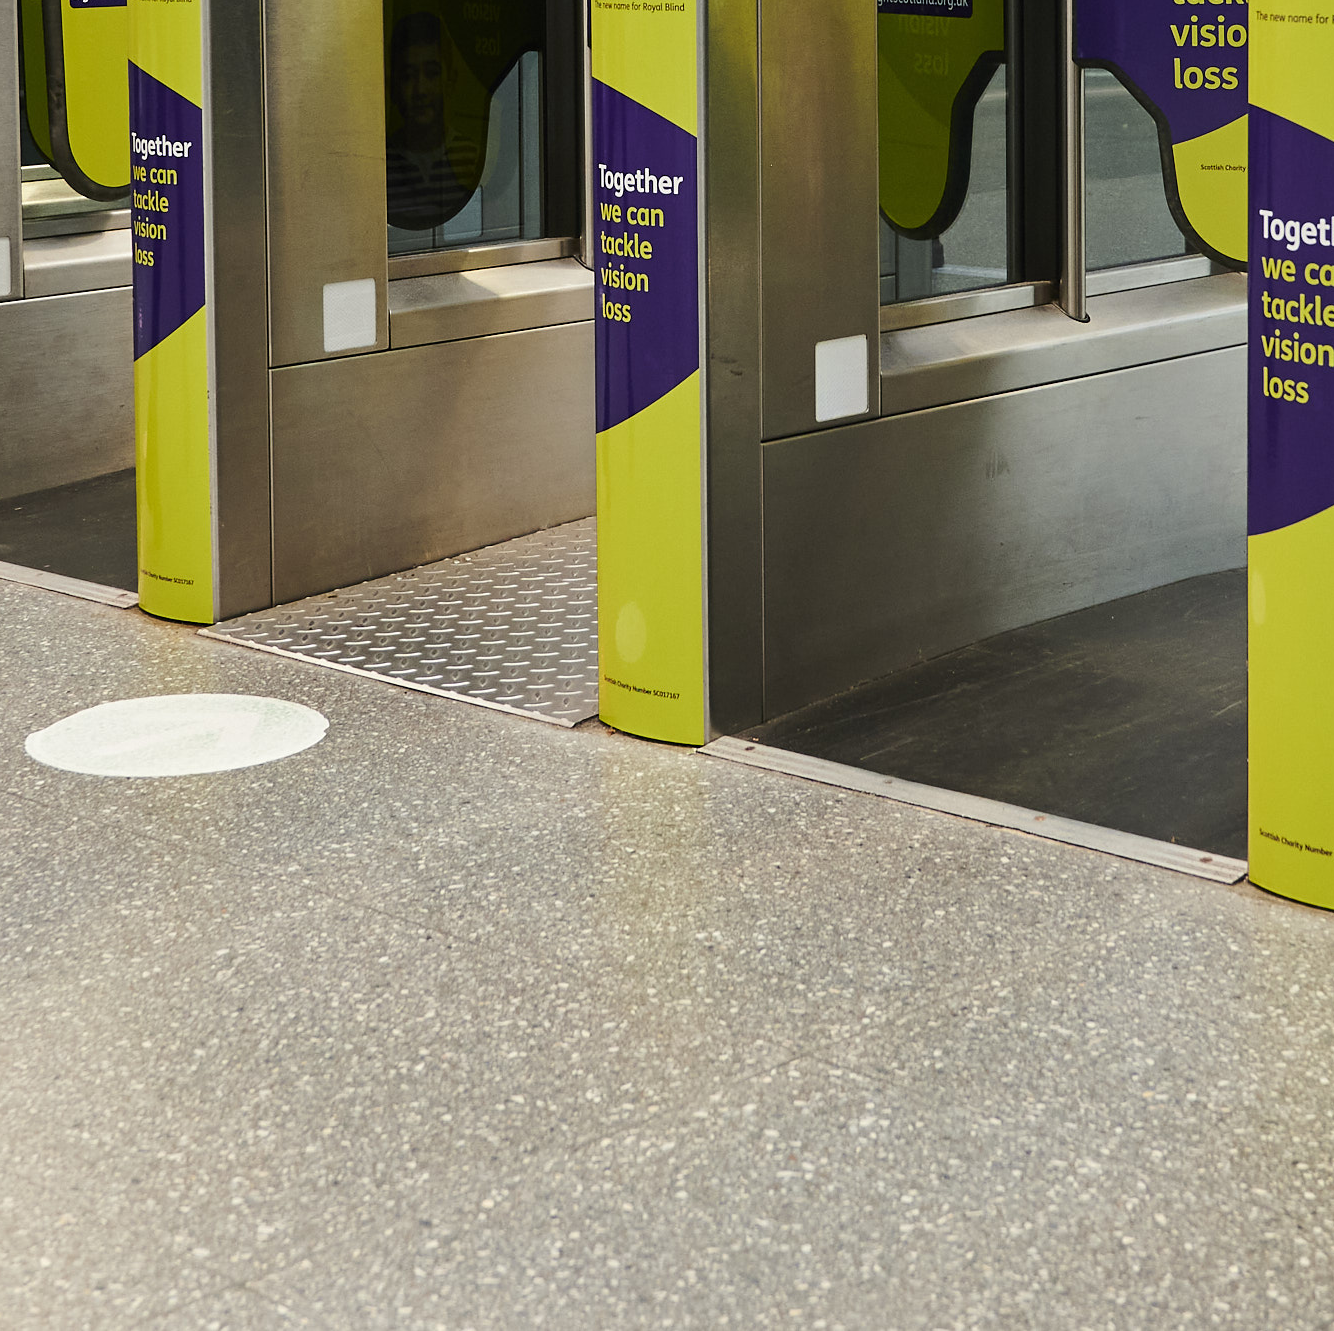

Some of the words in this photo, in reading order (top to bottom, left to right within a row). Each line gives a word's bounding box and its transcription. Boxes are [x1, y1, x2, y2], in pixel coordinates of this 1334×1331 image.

[631, 1, 641, 11] for
[642, 2, 663, 13] Royal
[665, 2, 685, 12] Blind
[1256, 10, 1268, 21] The
[1270, 13, 1286, 22] new
[1287, 14, 1313, 24] name
[1316, 13, 1329, 24] for
[1170, 15, 1248, 48] visio
[1173, 57, 1239, 90] loss
[131, 131, 193, 160] Together
[132, 165, 147, 182] we
[149, 167, 178, 186] can
[598, 163, 684, 198] Together
[1200, 163, 1224, 171] Scottish
[1225, 164, 1247, 173] Charity
[133, 189, 169, 213] tackle
[133, 215, 167, 241] vision
[600, 202, 622, 223] we
[626, 205, 665, 228] can
[134, 242, 155, 267] loss
[600, 230, 653, 260] tackle
[600, 261, 649, 293] vision
[1261, 256, 1297, 283] we
[602, 293, 632, 324] loss
[1262, 366, 1310, 404] loss
[1281, 836, 1304, 851] Charity
[1304, 844, 1333, 857] Number
